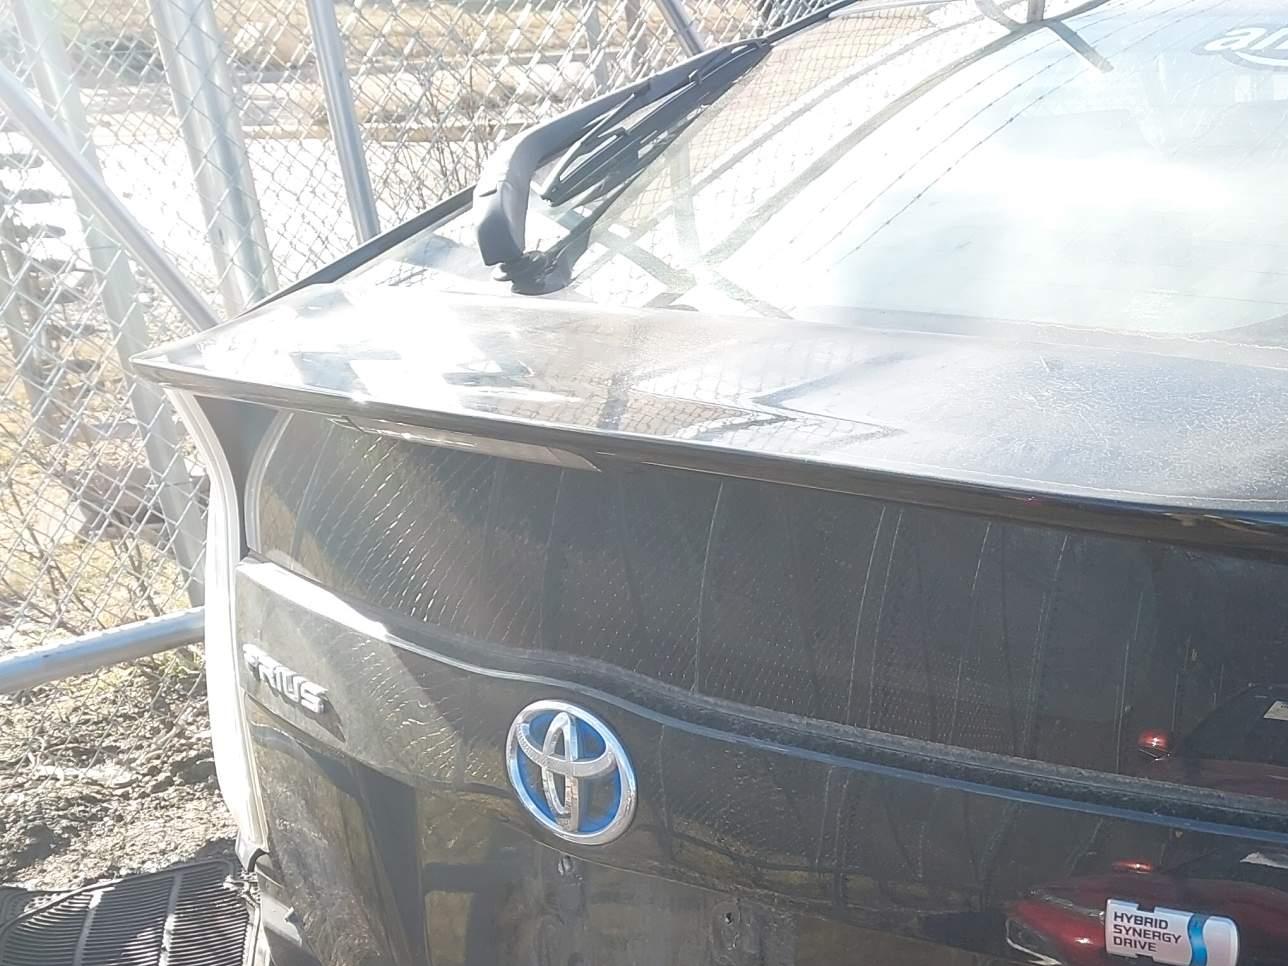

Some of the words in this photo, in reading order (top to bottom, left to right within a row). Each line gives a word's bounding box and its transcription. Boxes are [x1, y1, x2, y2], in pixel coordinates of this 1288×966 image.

[1113, 911, 1169, 930] HYBRID
[1113, 924, 1182, 944] SYNERGY
[1113, 935, 1157, 952] DRIVE
